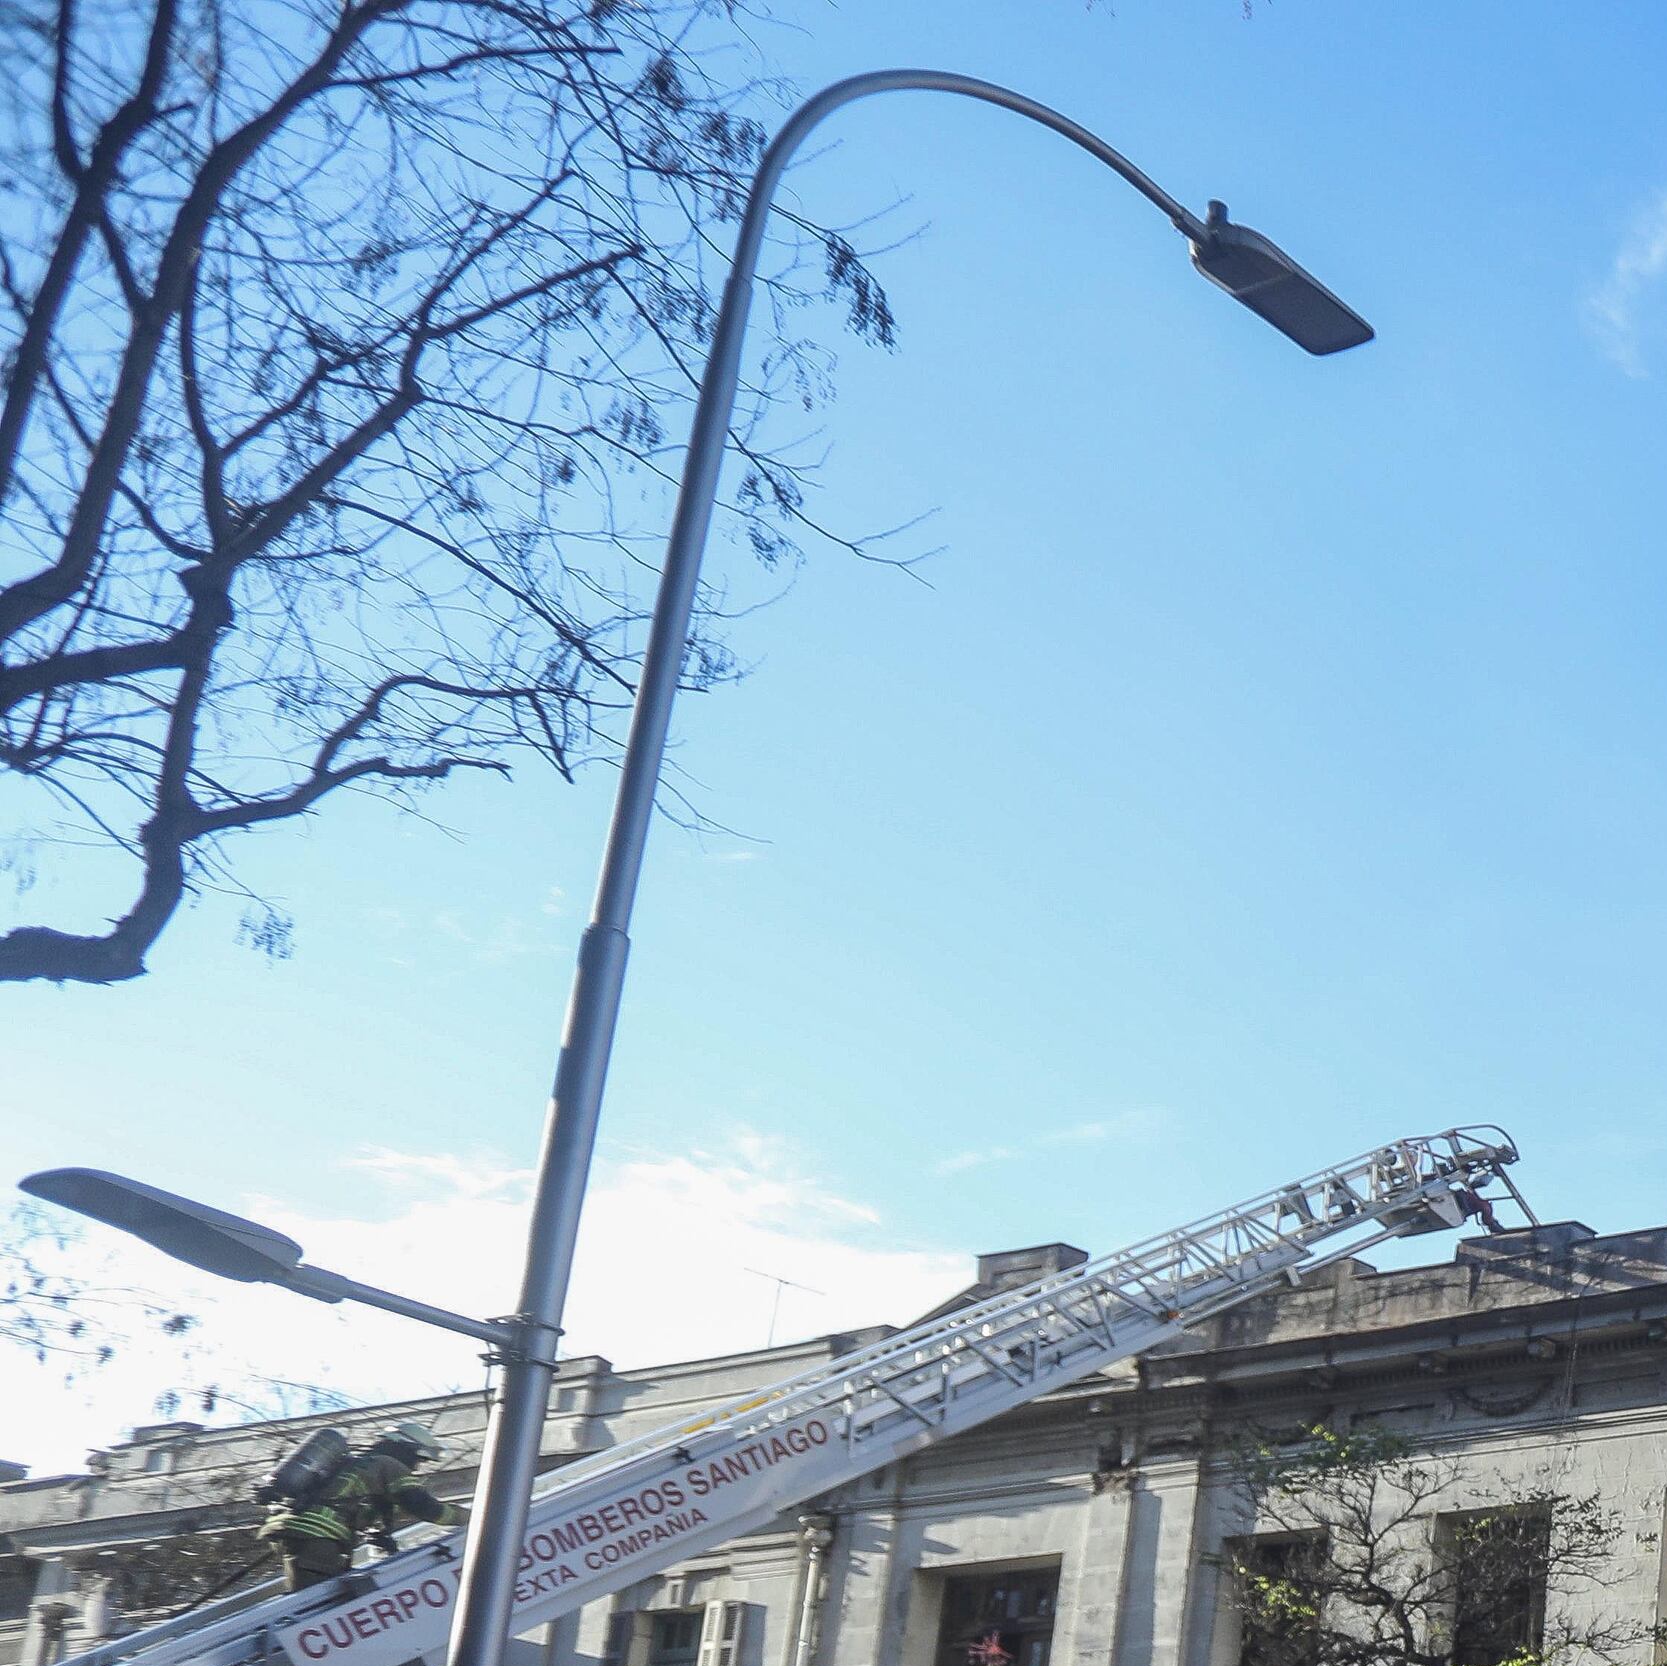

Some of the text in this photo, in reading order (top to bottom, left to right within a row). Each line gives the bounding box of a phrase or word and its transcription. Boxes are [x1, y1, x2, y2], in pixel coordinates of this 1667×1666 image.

[687, 1418, 829, 1496] SANTIAGO
[514, 1507, 708, 1604] EXTA COMPAÑIA
[297, 1577, 449, 1661] CUERPO
